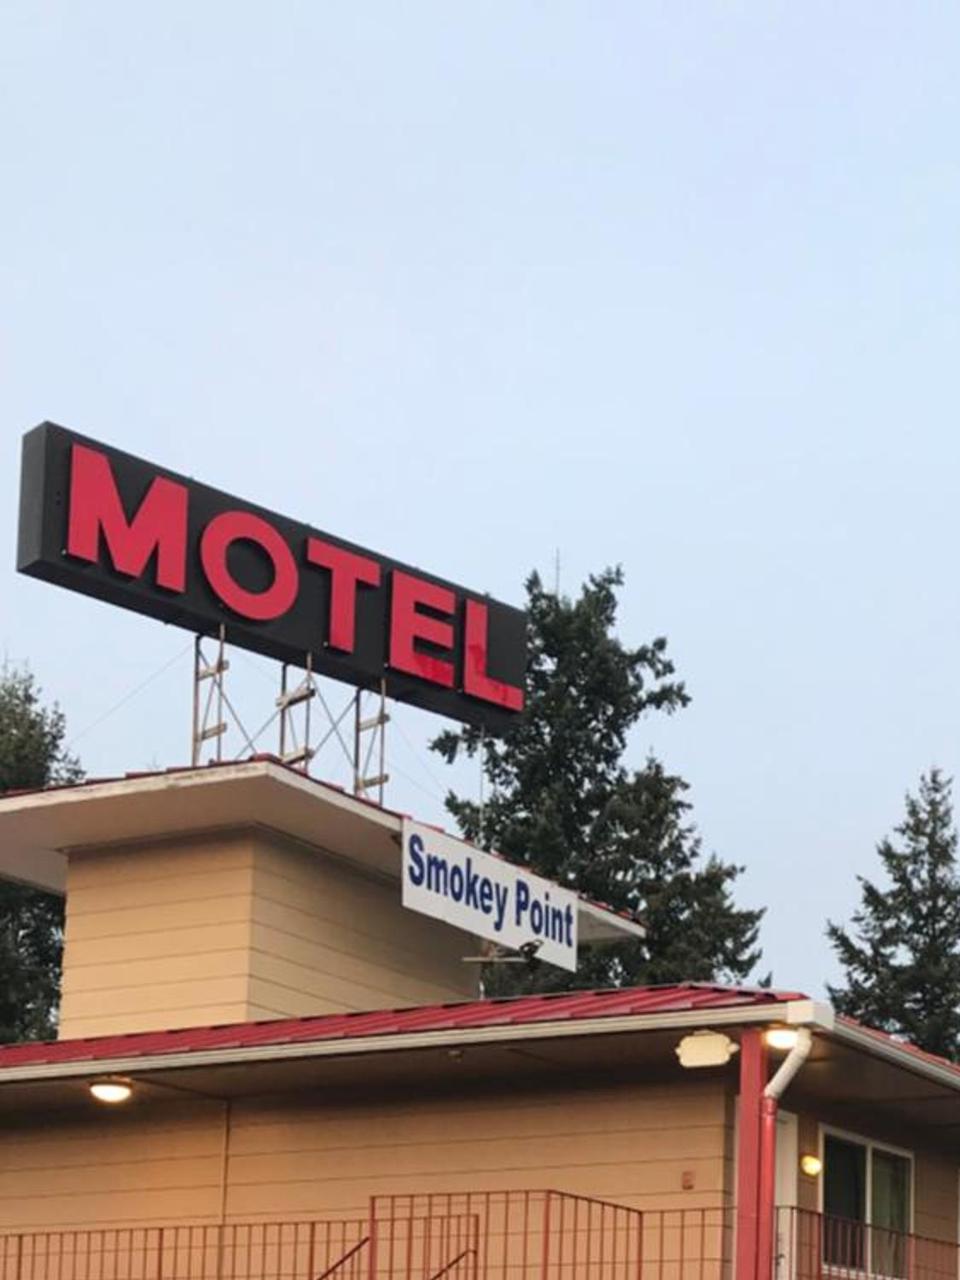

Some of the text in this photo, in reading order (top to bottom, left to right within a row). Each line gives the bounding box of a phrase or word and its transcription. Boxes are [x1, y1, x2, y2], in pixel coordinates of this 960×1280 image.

[66, 442, 524, 712] MOTEL
[408, 834, 574, 948] Smokey Point
